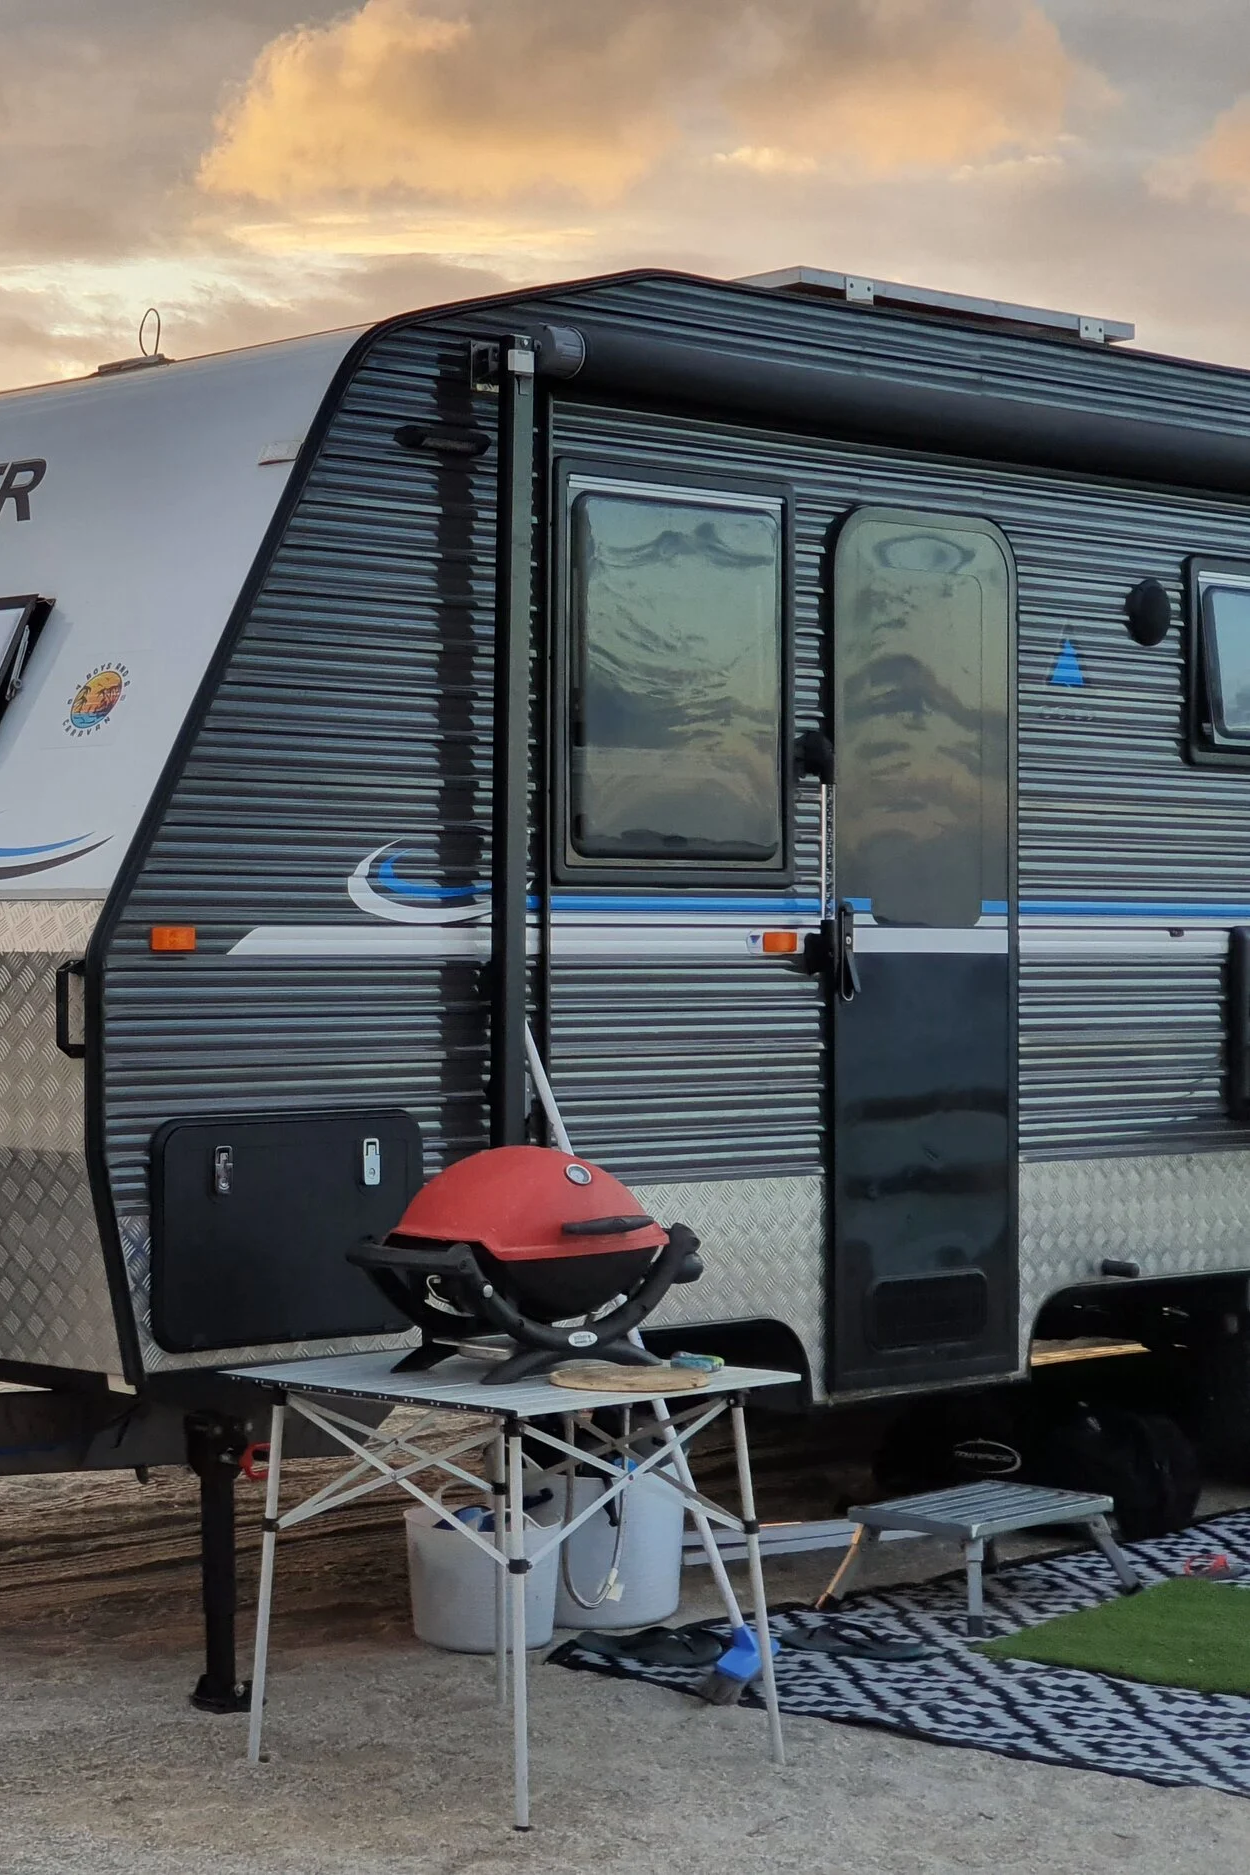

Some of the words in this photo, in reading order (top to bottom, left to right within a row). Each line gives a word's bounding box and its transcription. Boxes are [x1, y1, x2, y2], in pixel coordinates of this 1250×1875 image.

[86, 662, 113, 680] BOYS
[115, 662, 129, 678] AND
[62, 716, 111, 737] CARAVAN
